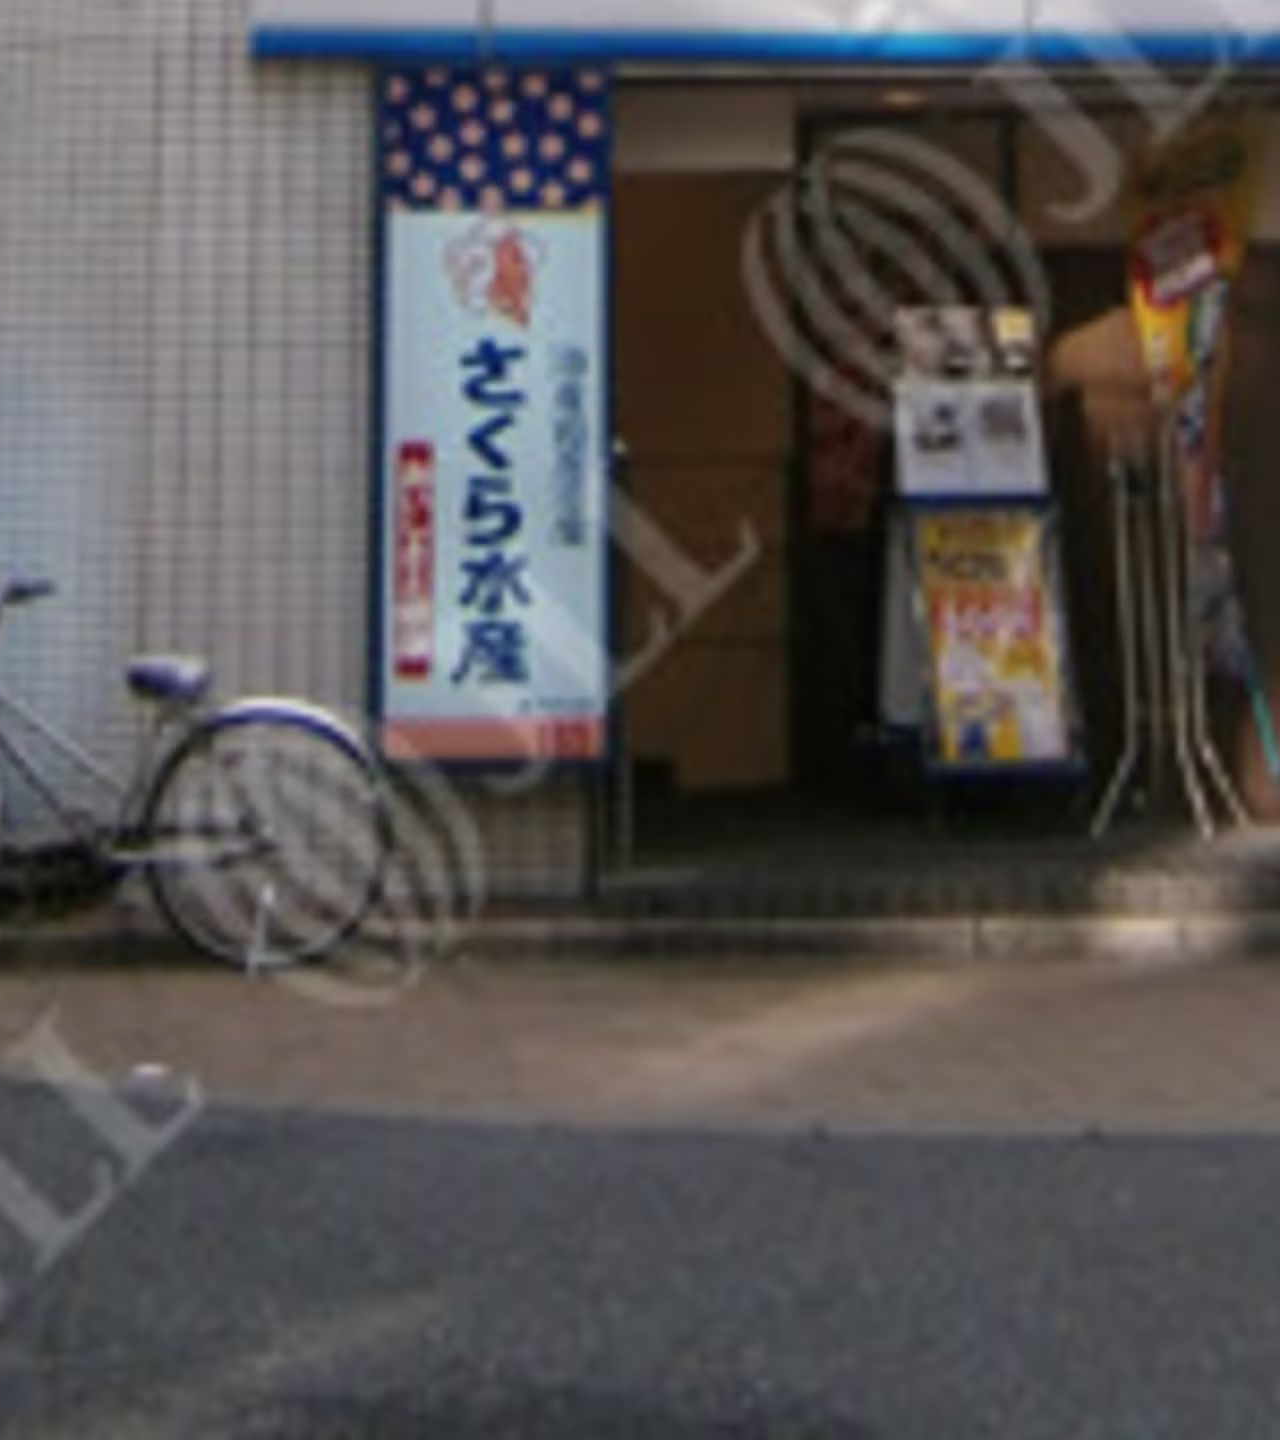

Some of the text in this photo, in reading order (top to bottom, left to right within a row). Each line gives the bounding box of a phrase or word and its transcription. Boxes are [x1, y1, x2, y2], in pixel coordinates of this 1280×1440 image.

[452, 339, 532, 685] さくら水産
